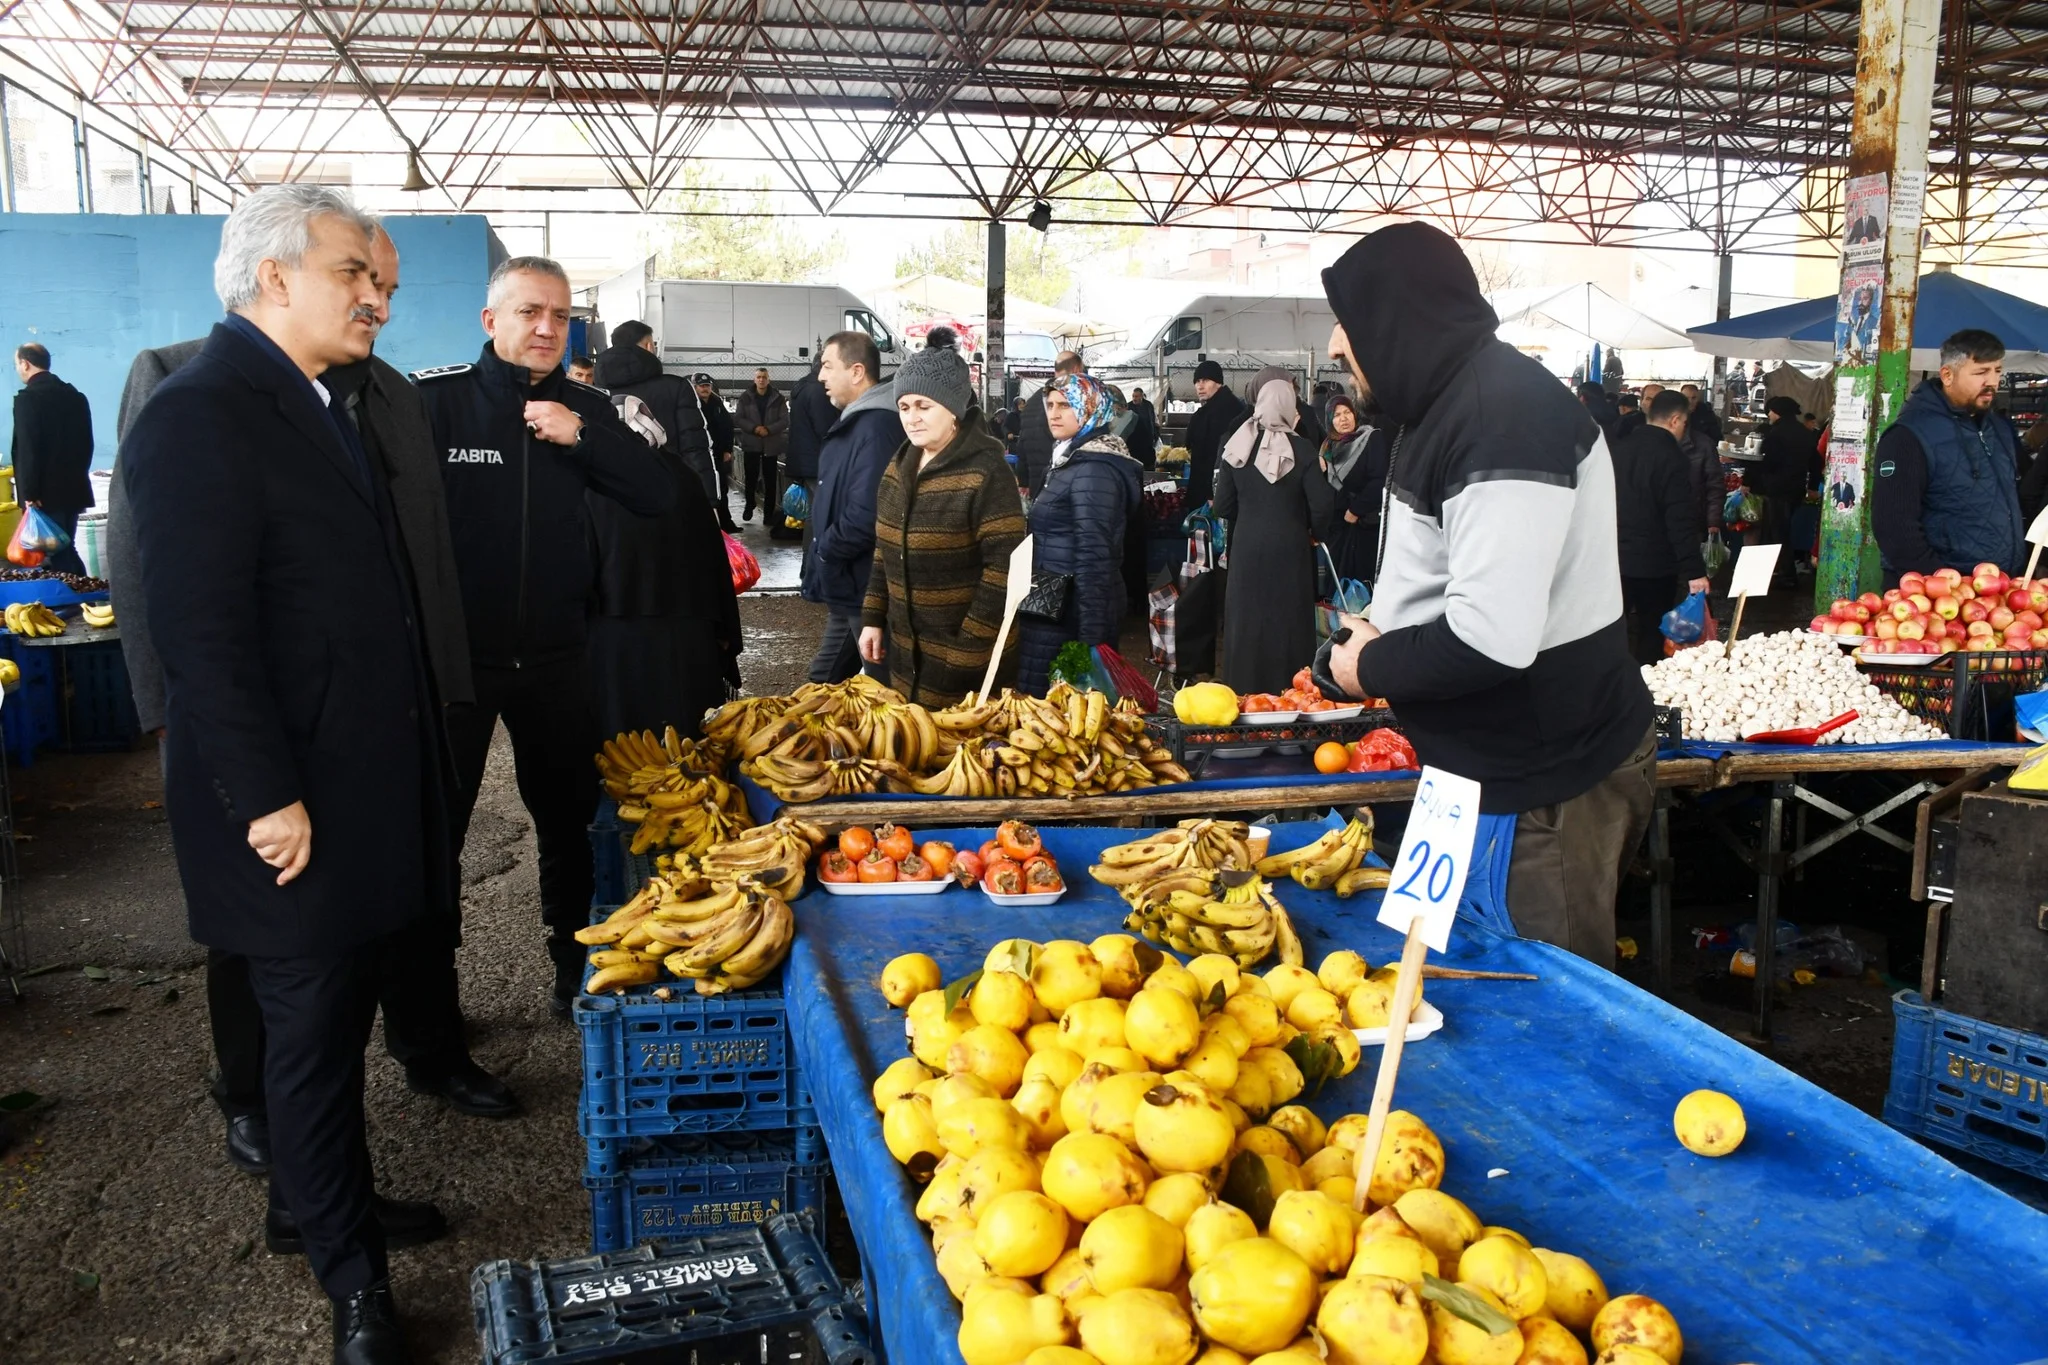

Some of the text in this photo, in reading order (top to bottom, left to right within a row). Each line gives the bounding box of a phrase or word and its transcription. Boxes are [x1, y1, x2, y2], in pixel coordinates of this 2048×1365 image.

[448, 448, 504, 464] ZABITA
[1393, 840, 1454, 903] 20
[642, 1048, 768, 1068] SAMET BEY
[642, 1207, 677, 1227] 122
[679, 1212, 723, 1226] GIDA
[563, 1262, 759, 1307] SAMET BEY
